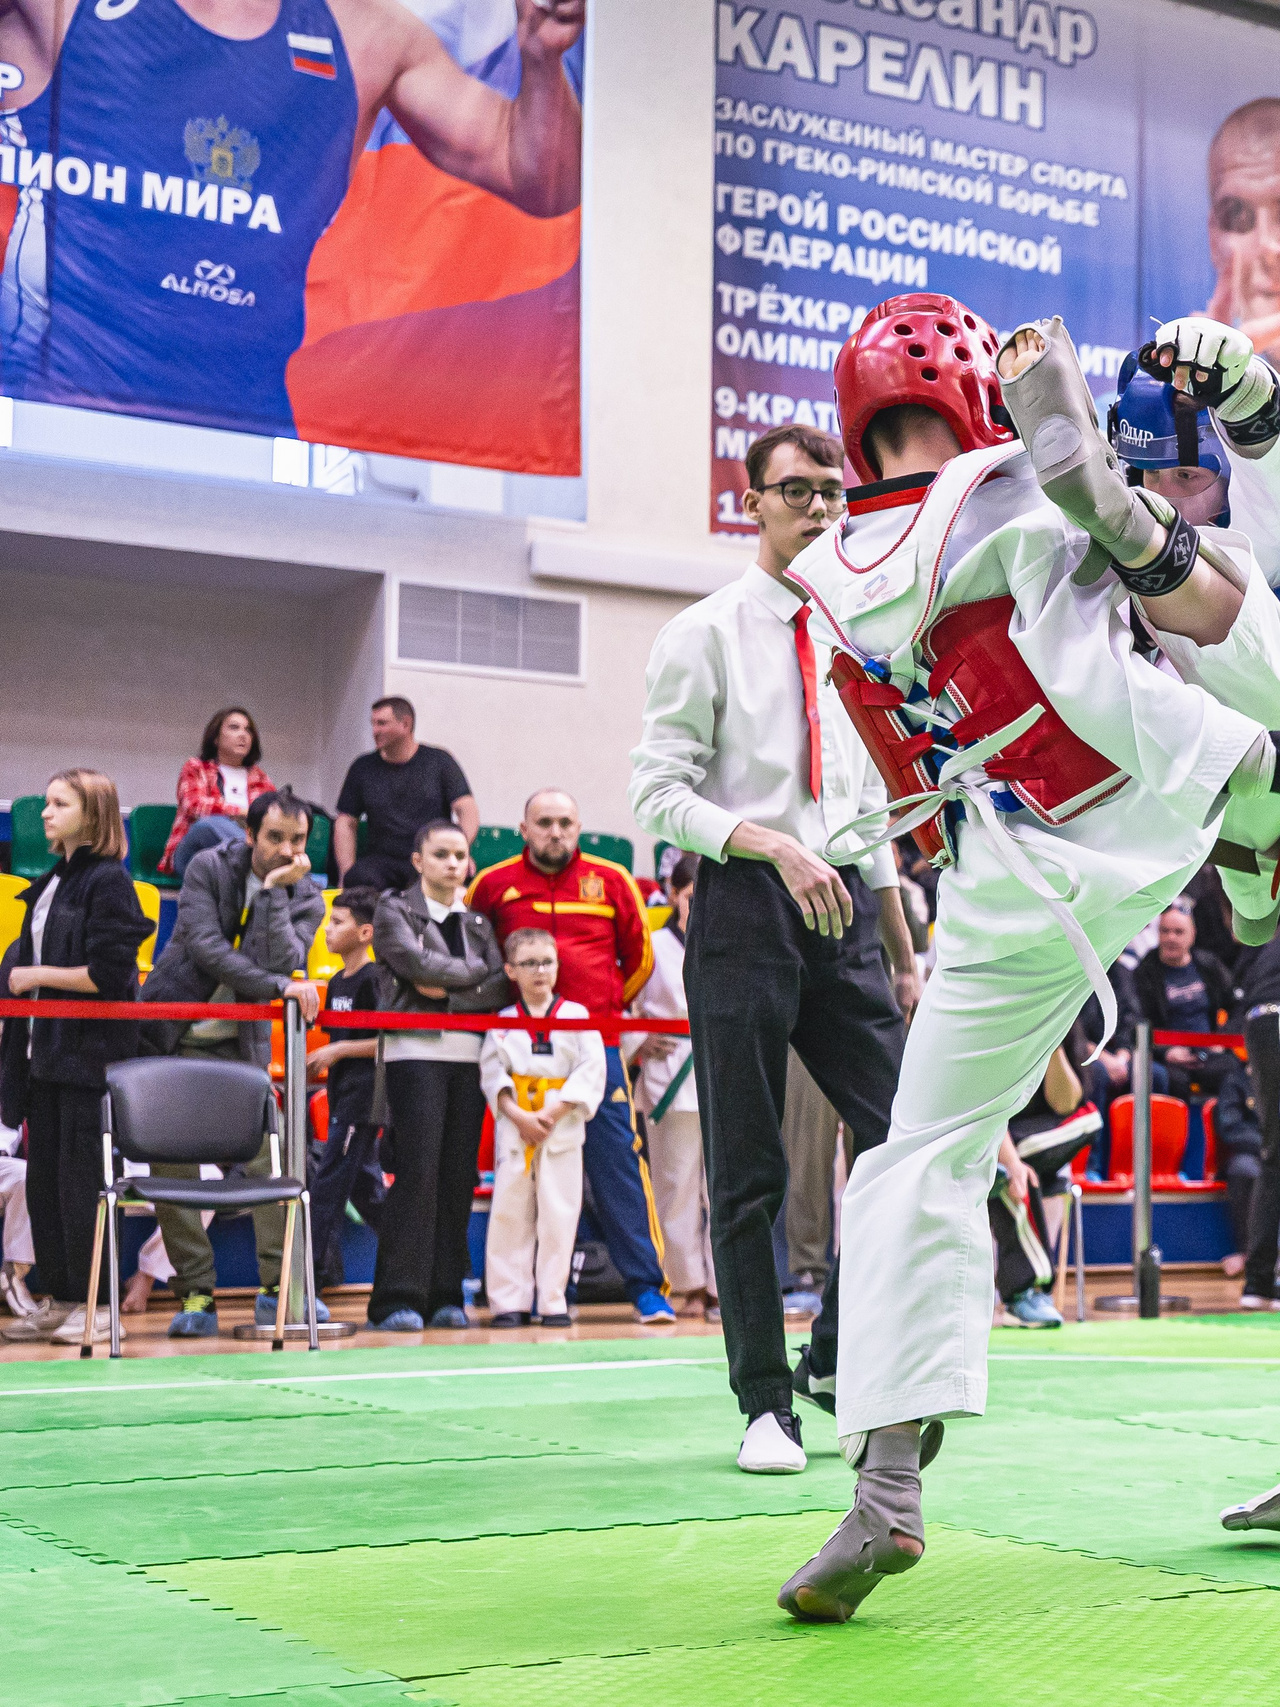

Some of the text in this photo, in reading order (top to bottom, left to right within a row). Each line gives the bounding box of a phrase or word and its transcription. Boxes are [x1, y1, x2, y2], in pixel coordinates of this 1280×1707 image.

[717, 4, 1044, 128] КАРЕЛИН
[715, 98, 1129, 199] ЗАСЛУЖЕННЫЙ МАСТЕР СПОРТА
[715, 132, 1101, 227] ПО ГРЕКО-РИМСКОЙ БОРЬБЕ
[142, 171, 282, 233] МИРА
[715, 184, 1062, 275] ГЕРОЙ РОССИЙСКОЙ
[715, 224, 928, 287] ФЕДЕРАЦИИ
